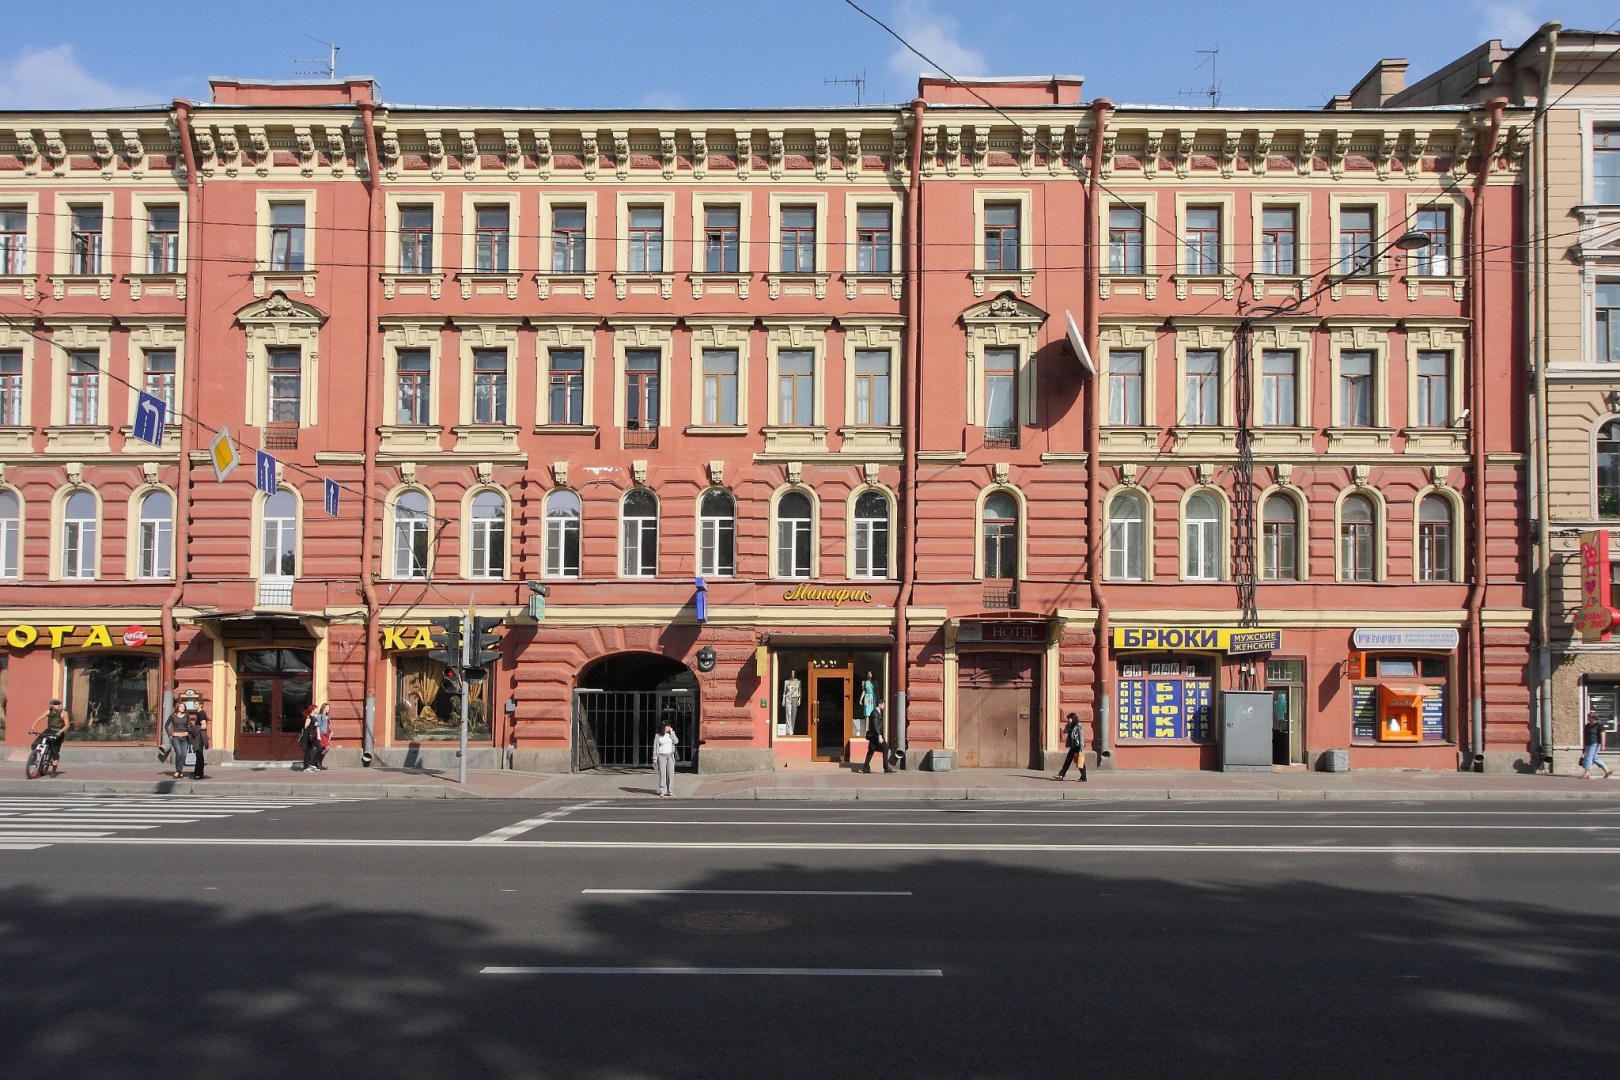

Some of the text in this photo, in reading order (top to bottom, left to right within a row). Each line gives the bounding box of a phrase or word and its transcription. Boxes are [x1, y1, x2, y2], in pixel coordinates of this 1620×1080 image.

[783, 583, 872, 607] Манифик
[992, 626, 1038, 638] HOTEL
[1124, 629, 1218, 648] БРЮКИ
[1234, 632, 1277, 642] МУЖСКИЕ
[1358, 634, 1403, 644] РЕМОНТ
[1233, 641, 1276, 651] ЖЕНСКИЕ
[1119, 682, 1129, 738] СОРОЧКИ
[1131, 682, 1144, 738] КОСТЮМЫ
[1151, 682, 1179, 737] БРЮКИ
[1185, 682, 1196, 737] МУЖСКИЕ
[1198, 682, 1210, 738] ЖЕНСКИЕ
